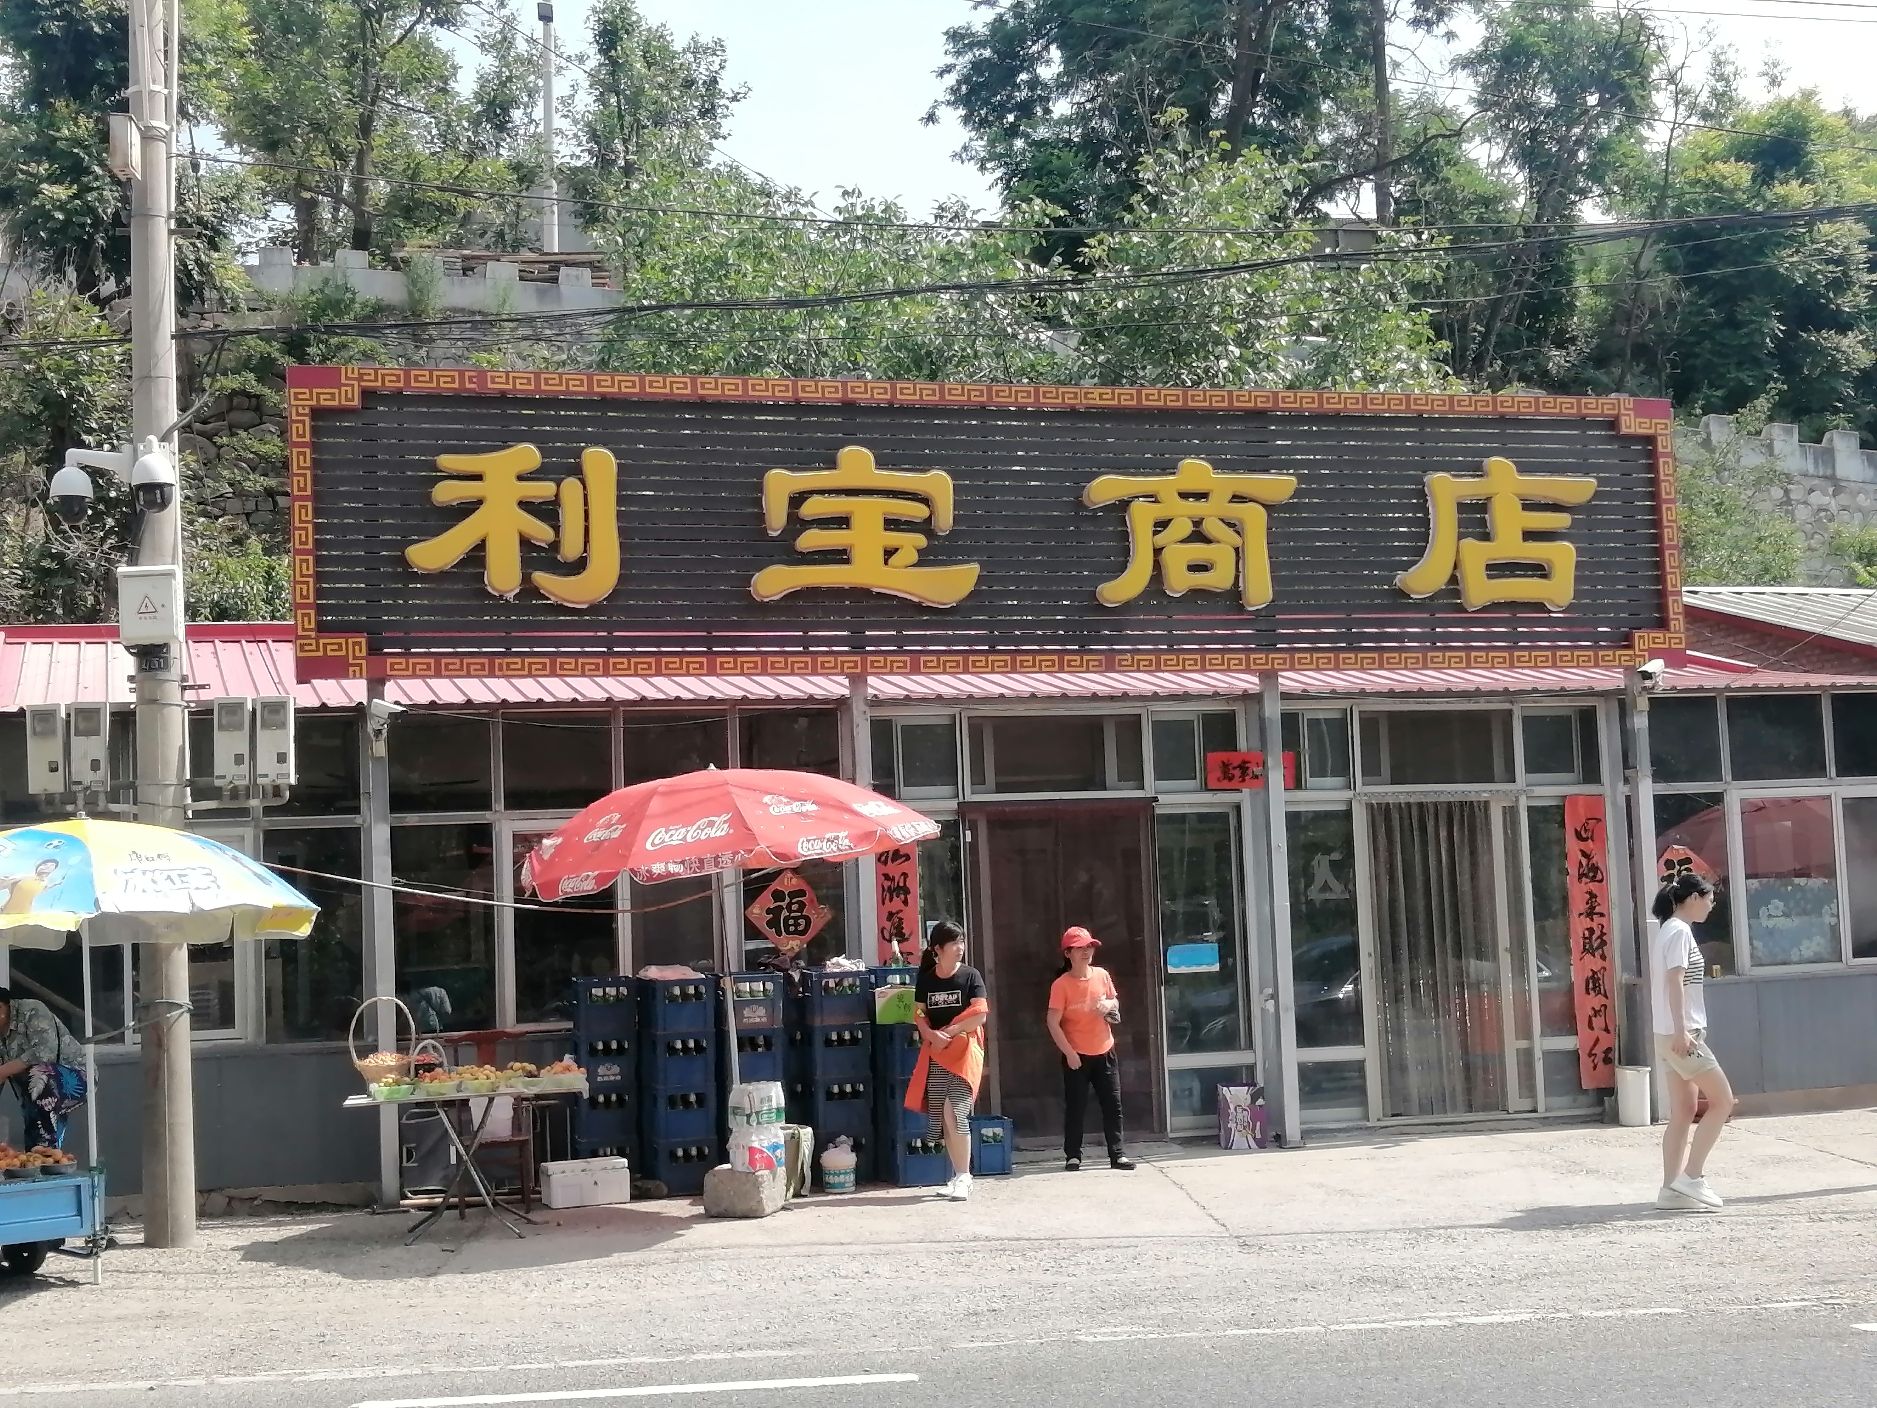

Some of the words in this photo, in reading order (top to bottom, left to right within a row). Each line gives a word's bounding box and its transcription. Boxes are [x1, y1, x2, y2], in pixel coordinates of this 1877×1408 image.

[404, 442, 1598, 611] 利宝商店
[645, 812, 732, 851] Coca-Cola
[765, 888, 813, 938] 福
